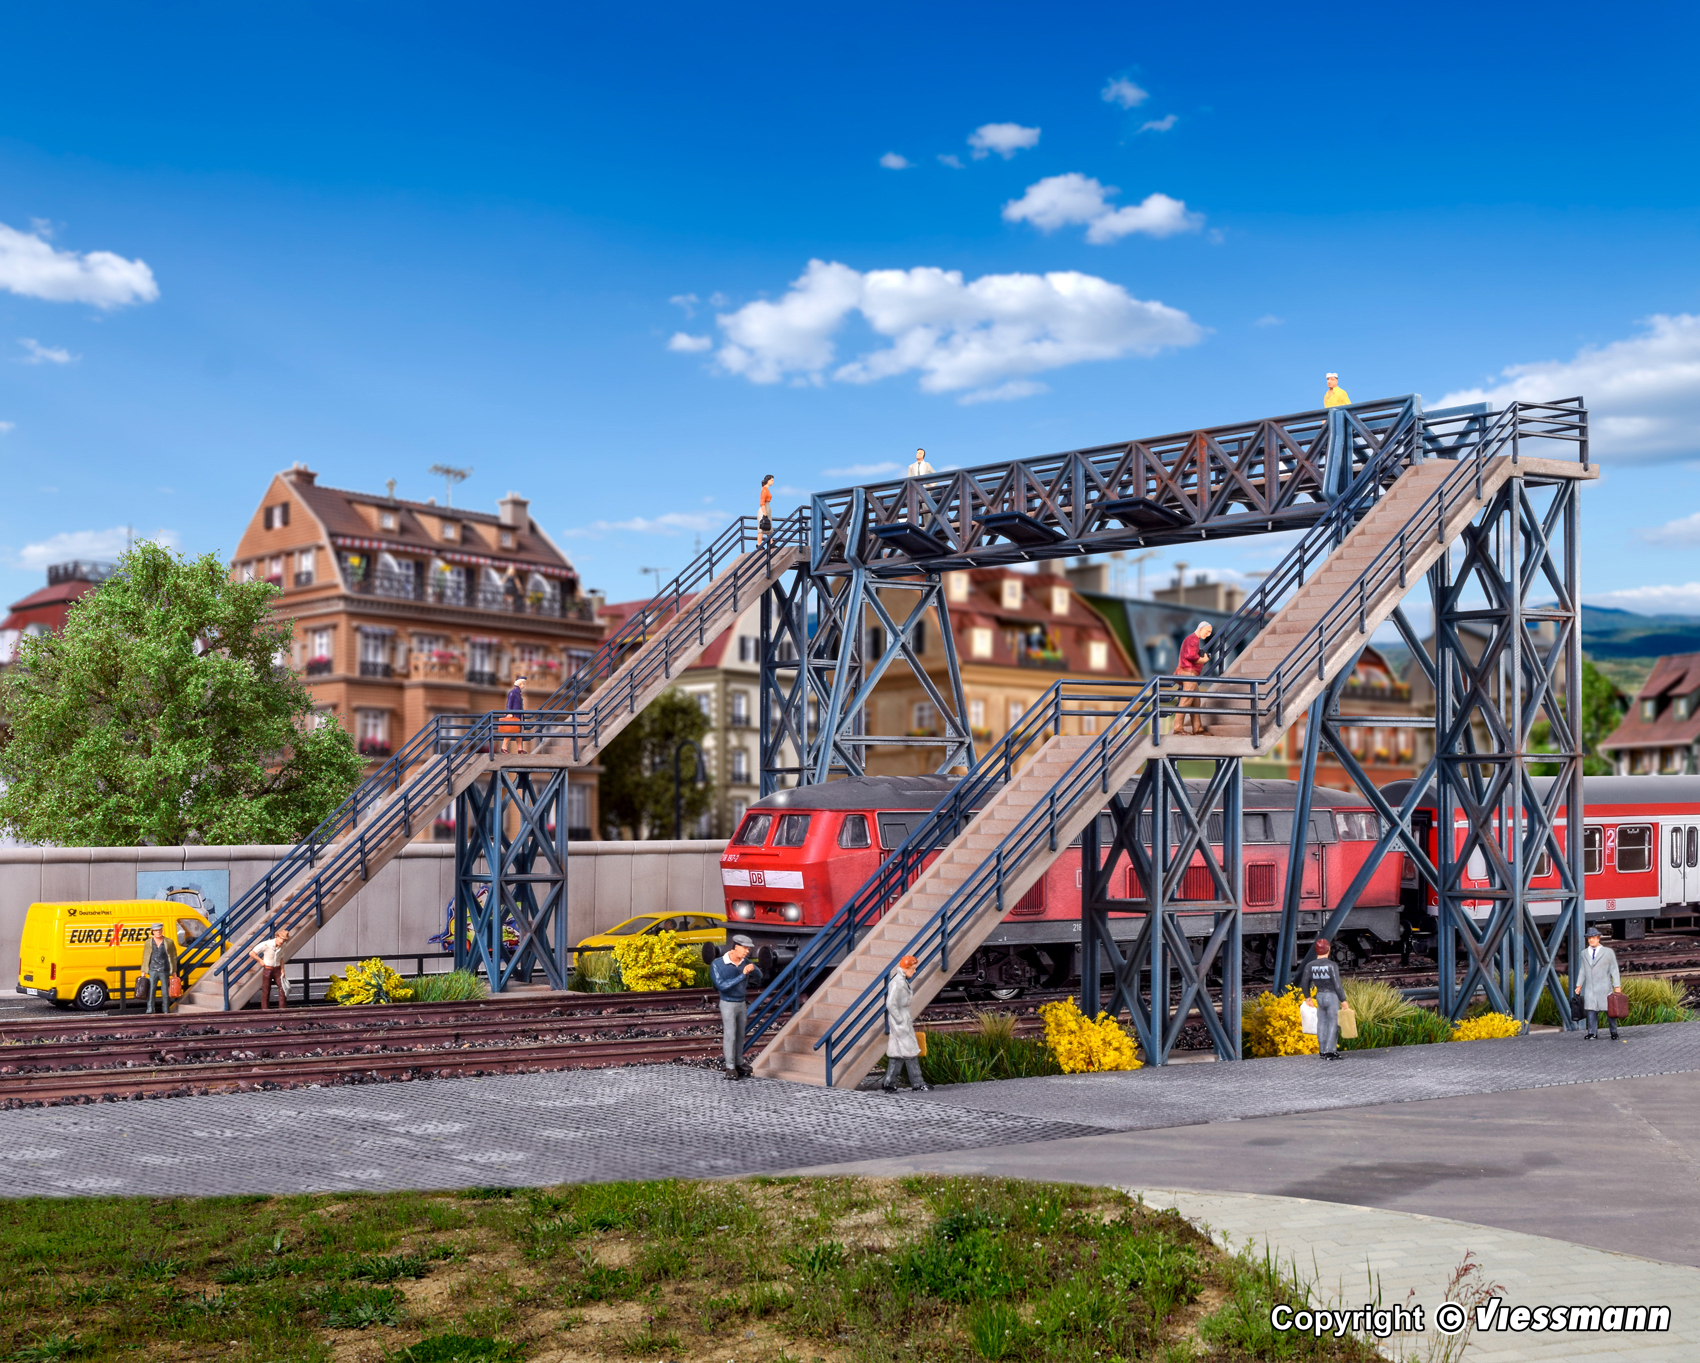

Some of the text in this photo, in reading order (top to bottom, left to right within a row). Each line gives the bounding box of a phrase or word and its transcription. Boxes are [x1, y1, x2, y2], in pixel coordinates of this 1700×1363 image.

[1606, 829, 1615, 846] 2
[751, 872, 763, 884] DB
[69, 929, 103, 944] EURO
